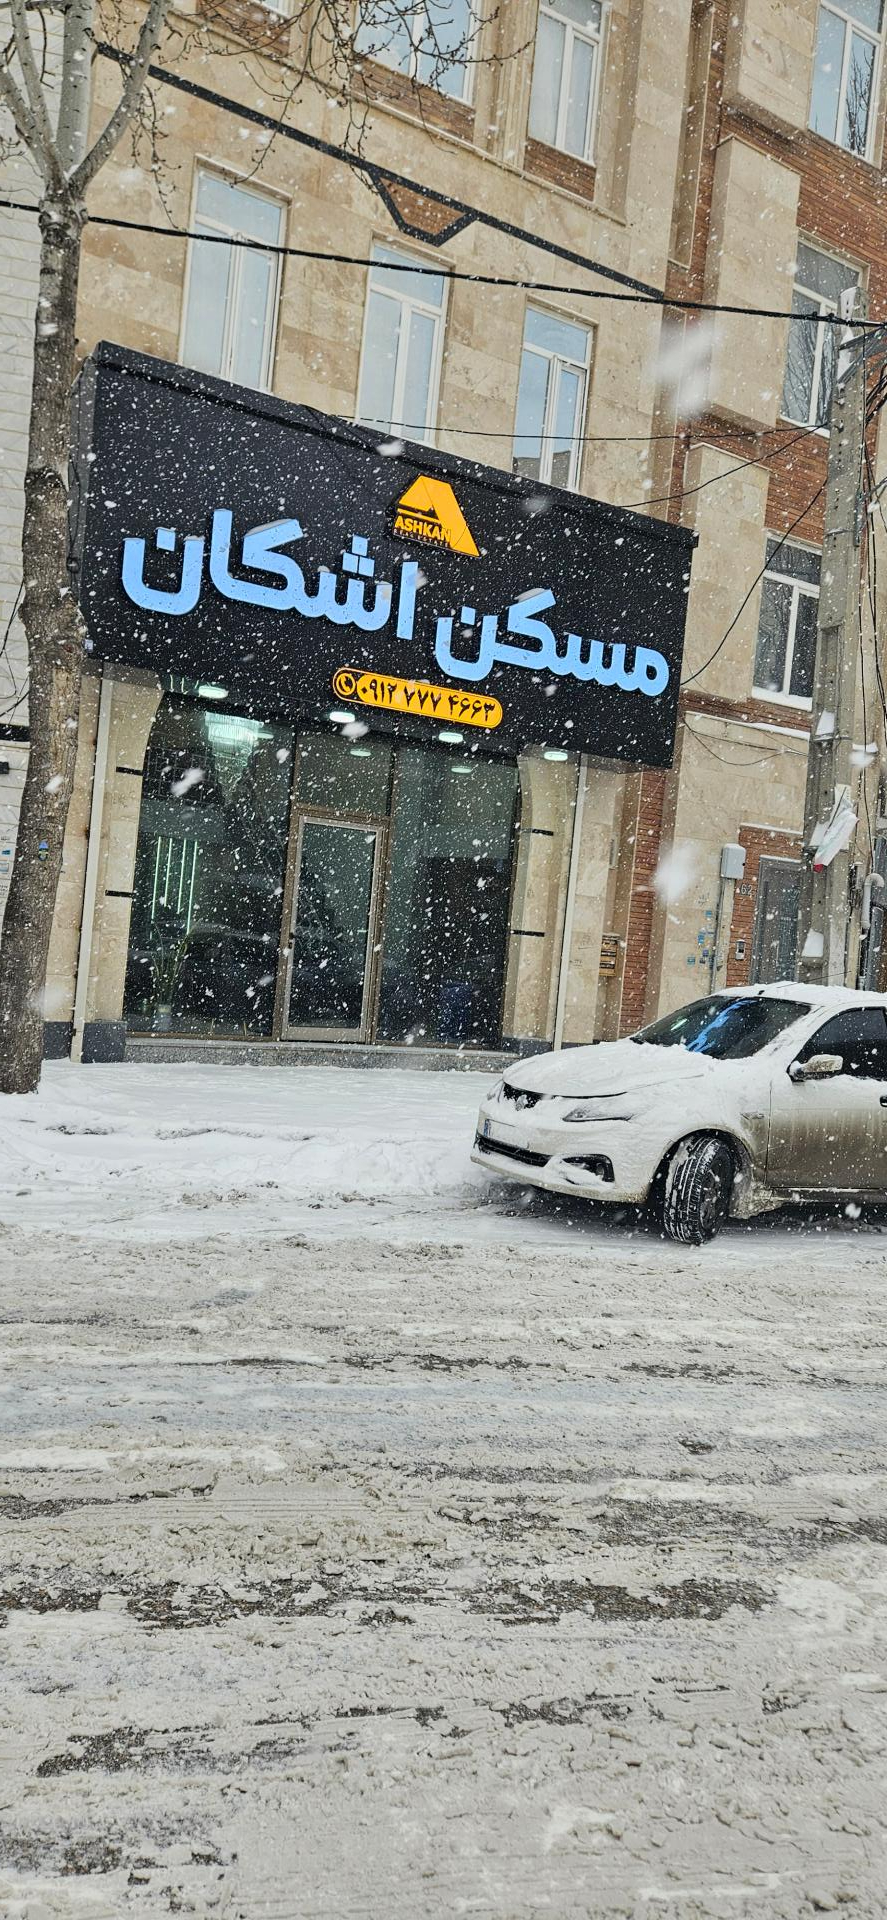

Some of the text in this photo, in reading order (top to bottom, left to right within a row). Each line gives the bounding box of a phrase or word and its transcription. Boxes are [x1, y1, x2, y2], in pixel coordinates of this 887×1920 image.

[394, 515, 452, 543] ASHKAN
[121, 508, 670, 697] مسکن اشکان
[403, 685, 442, 712] ۷۷۷
[448, 694, 496, 722] ۴۶۶۳
